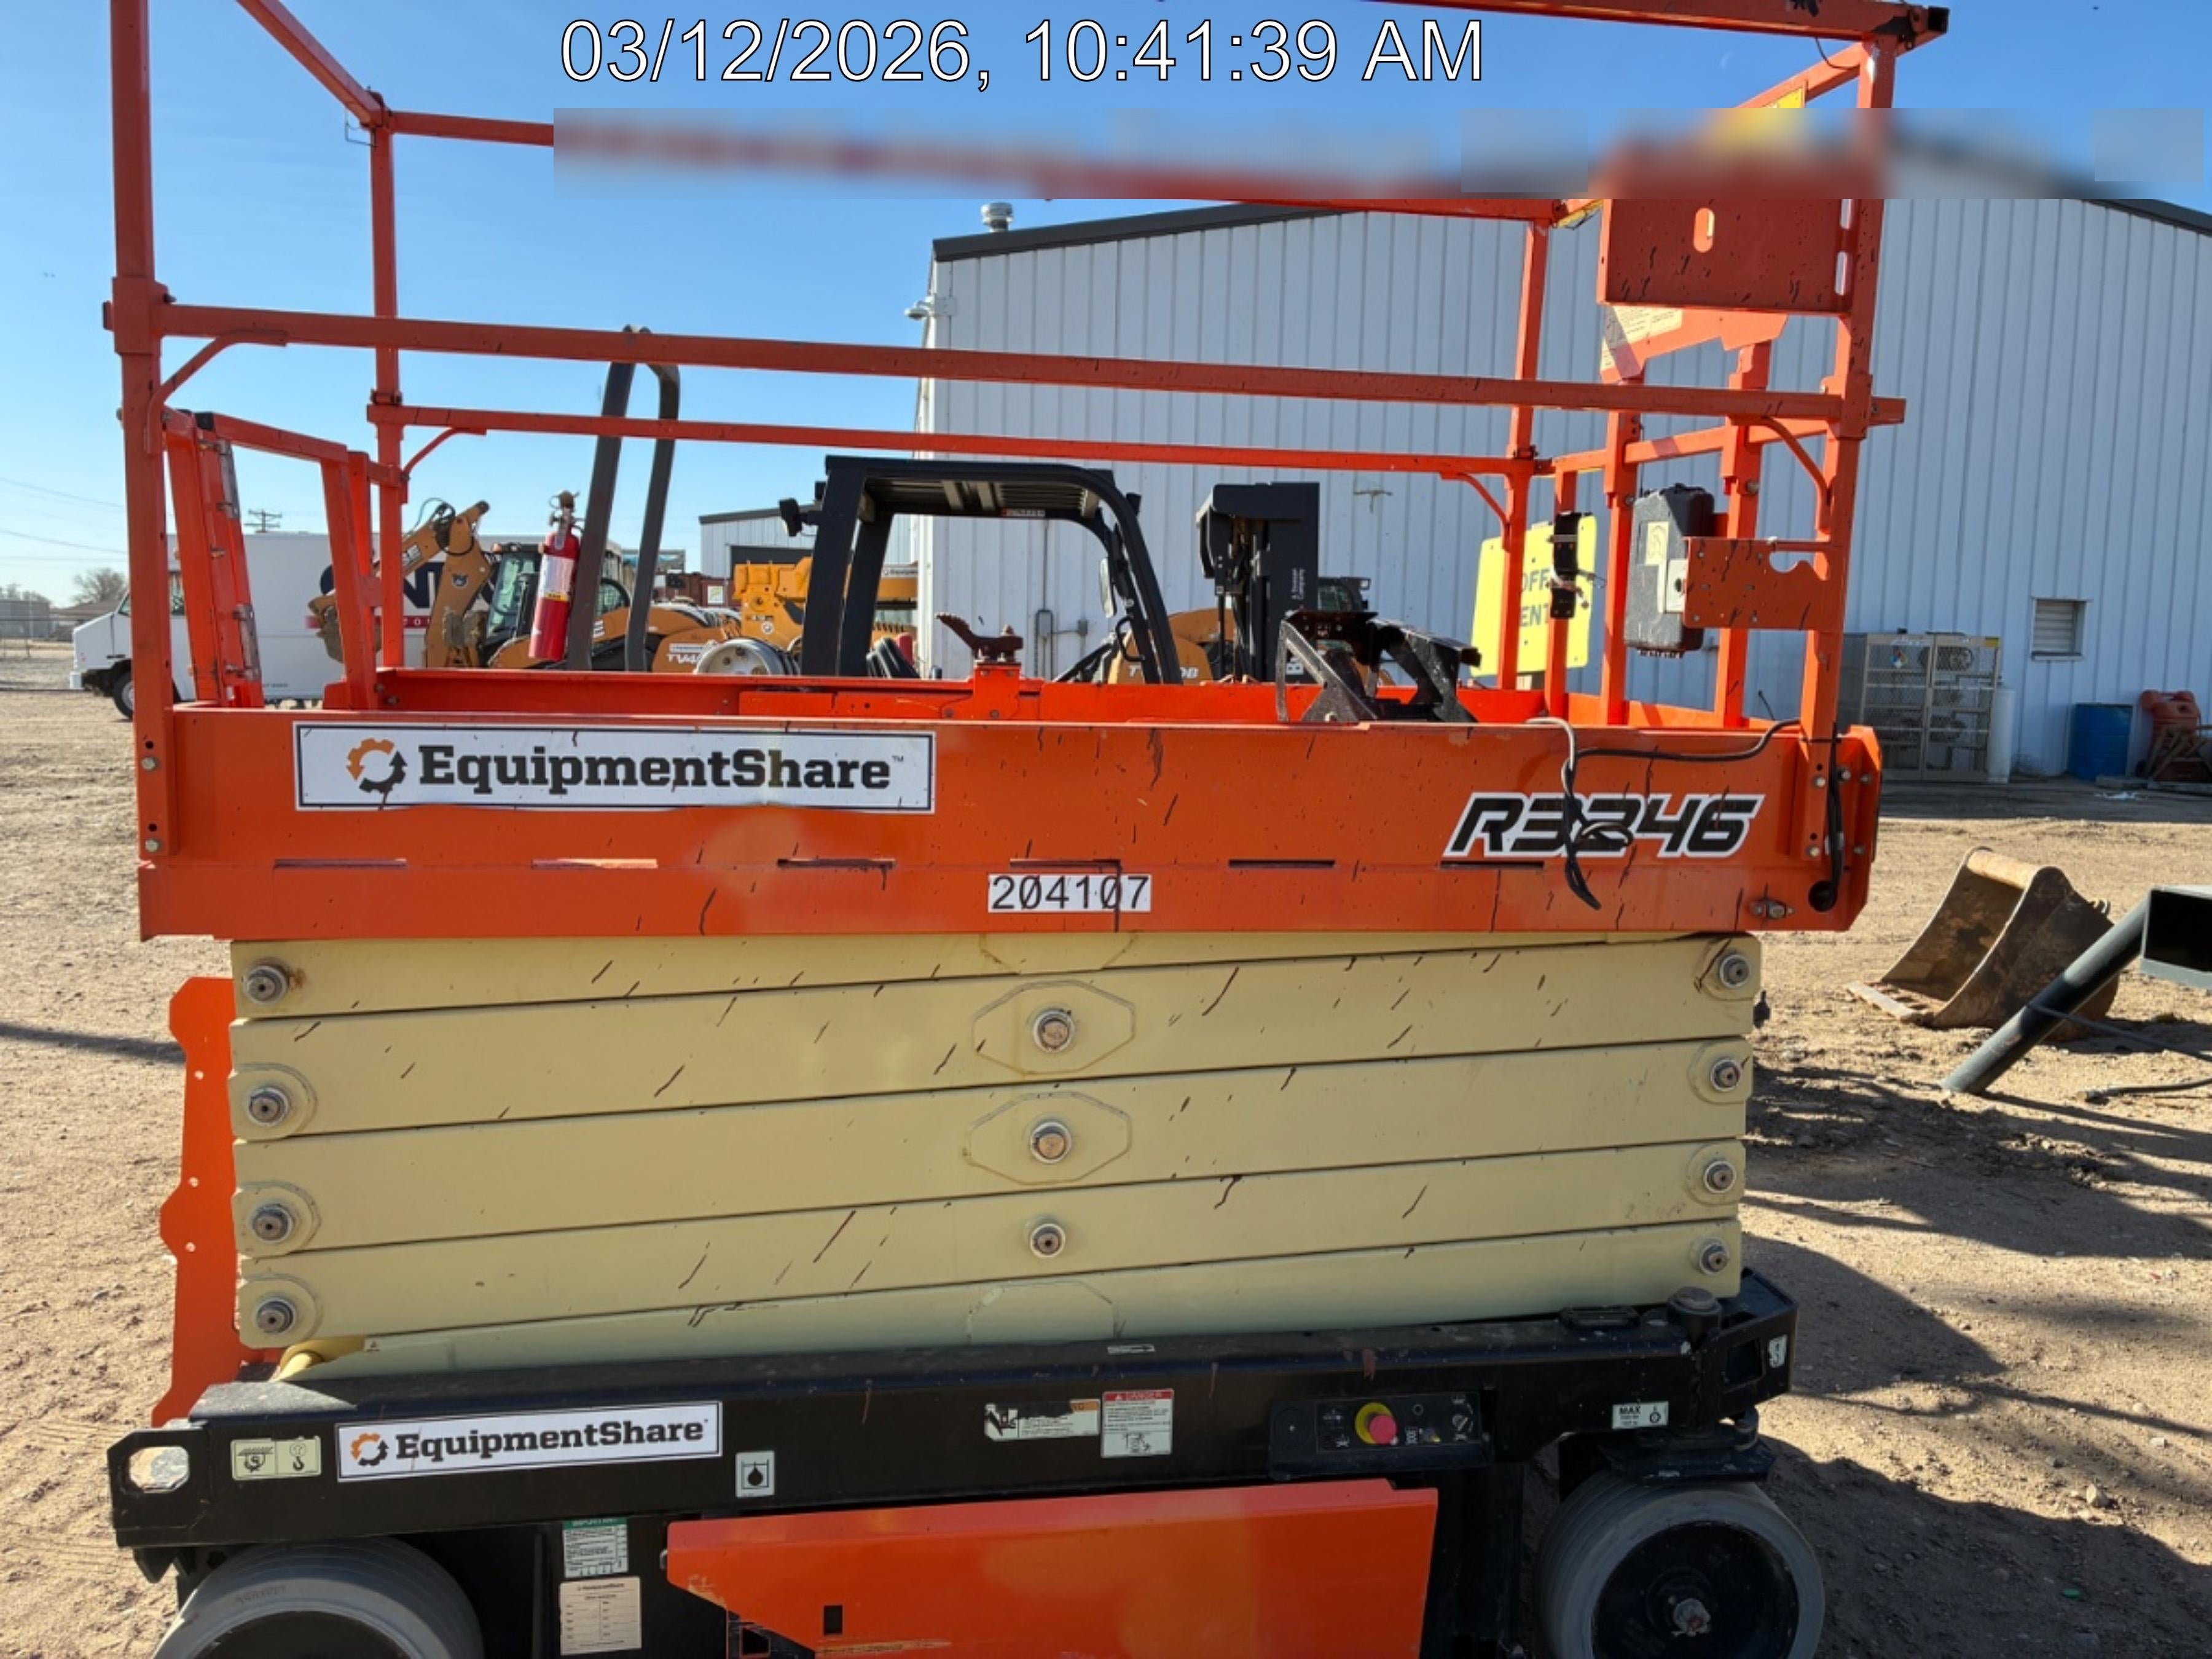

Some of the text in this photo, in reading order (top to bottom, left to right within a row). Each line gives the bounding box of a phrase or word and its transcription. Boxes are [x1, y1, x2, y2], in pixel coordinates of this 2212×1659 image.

[419, 746, 890, 794] EquipmentShare
[1444, 793, 1764, 858] R3246
[991, 875, 1149, 909] 204107
[396, 1421, 704, 1462] EquipmentShare
